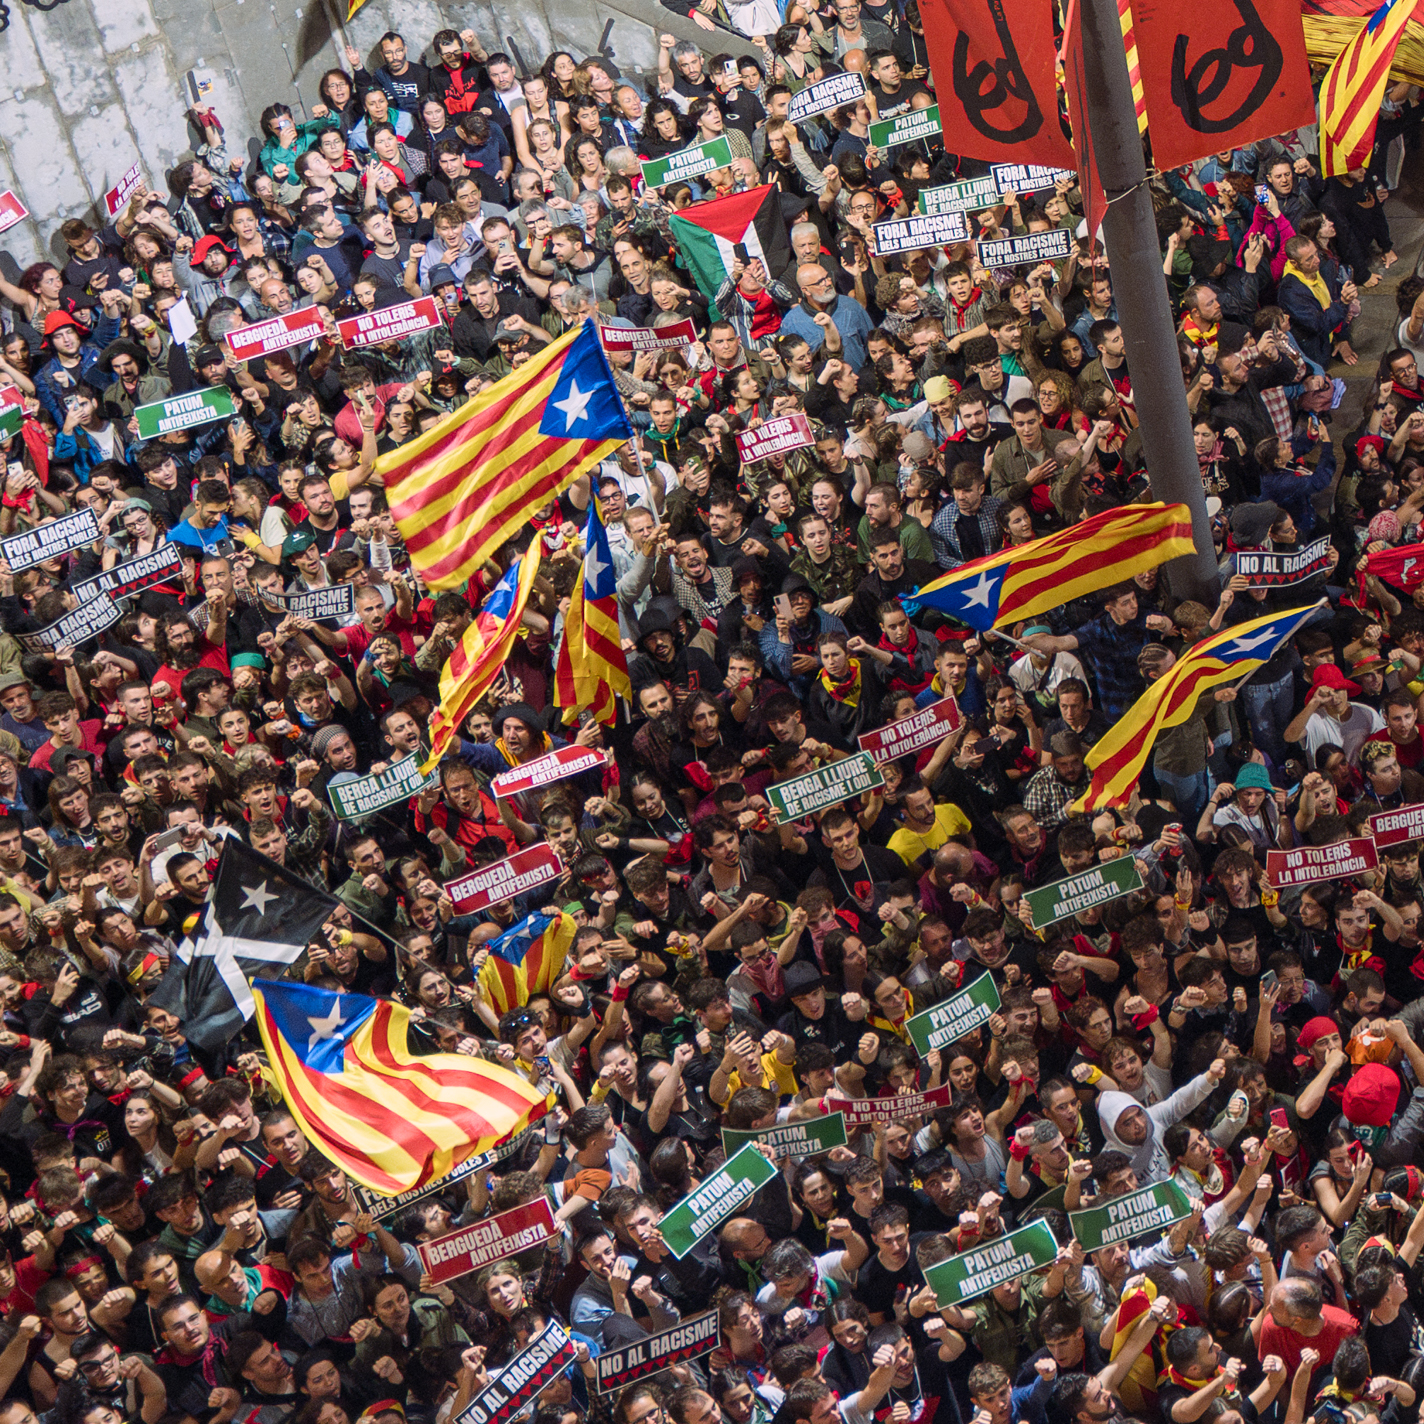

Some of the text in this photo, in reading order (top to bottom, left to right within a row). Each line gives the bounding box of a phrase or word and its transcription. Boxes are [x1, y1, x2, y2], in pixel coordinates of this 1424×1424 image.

[888, 120, 939, 144] ANTIFEIXISTA
[894, 111, 928, 130] PATUM
[663, 157, 717, 182] ANTIFEIXISTA
[669, 148, 704, 169] PATUM
[877, 214, 963, 240] FORA RACISME
[879, 228, 964, 252] DELS NOSTRES POBLES
[982, 231, 1066, 257] FORA RACISME
[983, 245, 1068, 268] DELS NOSTRES POBLES
[357, 303, 416, 331] NO TOLERIS
[263, 323, 320, 351] ANTIFEIXISTA
[353, 331, 365, 345] LA
[632, 335, 690, 349] ANTIFEIXISTA
[159, 406, 217, 432] ANTIFEIXISTA
[164, 395, 204, 415] PATUM
[741, 419, 792, 446] NO TOLERIS
[742, 450, 750, 461] LA
[4, 511, 95, 556] FORA RACISME
[9, 526, 99, 569] DELS NOSTRES POBLES
[1241, 539, 1328, 573] NO AL RACISME
[77, 547, 178, 602] NO AL RACISME
[880, 709, 937, 745] NO TOLERIS
[532, 753, 597, 784] ANTIFEIXISTA
[875, 748, 888, 762] LA
[780, 757, 868, 803] BERGA LLIURE
[785, 803, 801, 817] DE
[803, 786, 840, 812] RACISME
[849, 773, 872, 790] ODI
[1287, 843, 1351, 867] NO TOLERIS
[488, 864, 555, 902] ANTIFEIXISTA
[1059, 870, 1103, 898] PATUM
[1278, 871, 1292, 884] LA
[1054, 882, 1120, 916] ANTIFEIXISTA
[927, 1003, 991, 1048] ANTIFEIXISTA
[929, 994, 975, 1028] PATUM
[688, 1171, 735, 1216] PATUM
[690, 1177, 755, 1238] ANTIFEIXISTA
[1108, 1190, 1157, 1223] PATUM
[1101, 1204, 1174, 1244] ANTIFEIXISTA
[470, 1223, 548, 1266] ANTIFEIXISTA
[963, 1240, 1015, 1274] PATUM
[959, 1252, 1035, 1296] ANTIFEIXISTA
[600, 1315, 717, 1377] NO AL RACISME
[462, 1326, 568, 1424] NO AL RACISME
